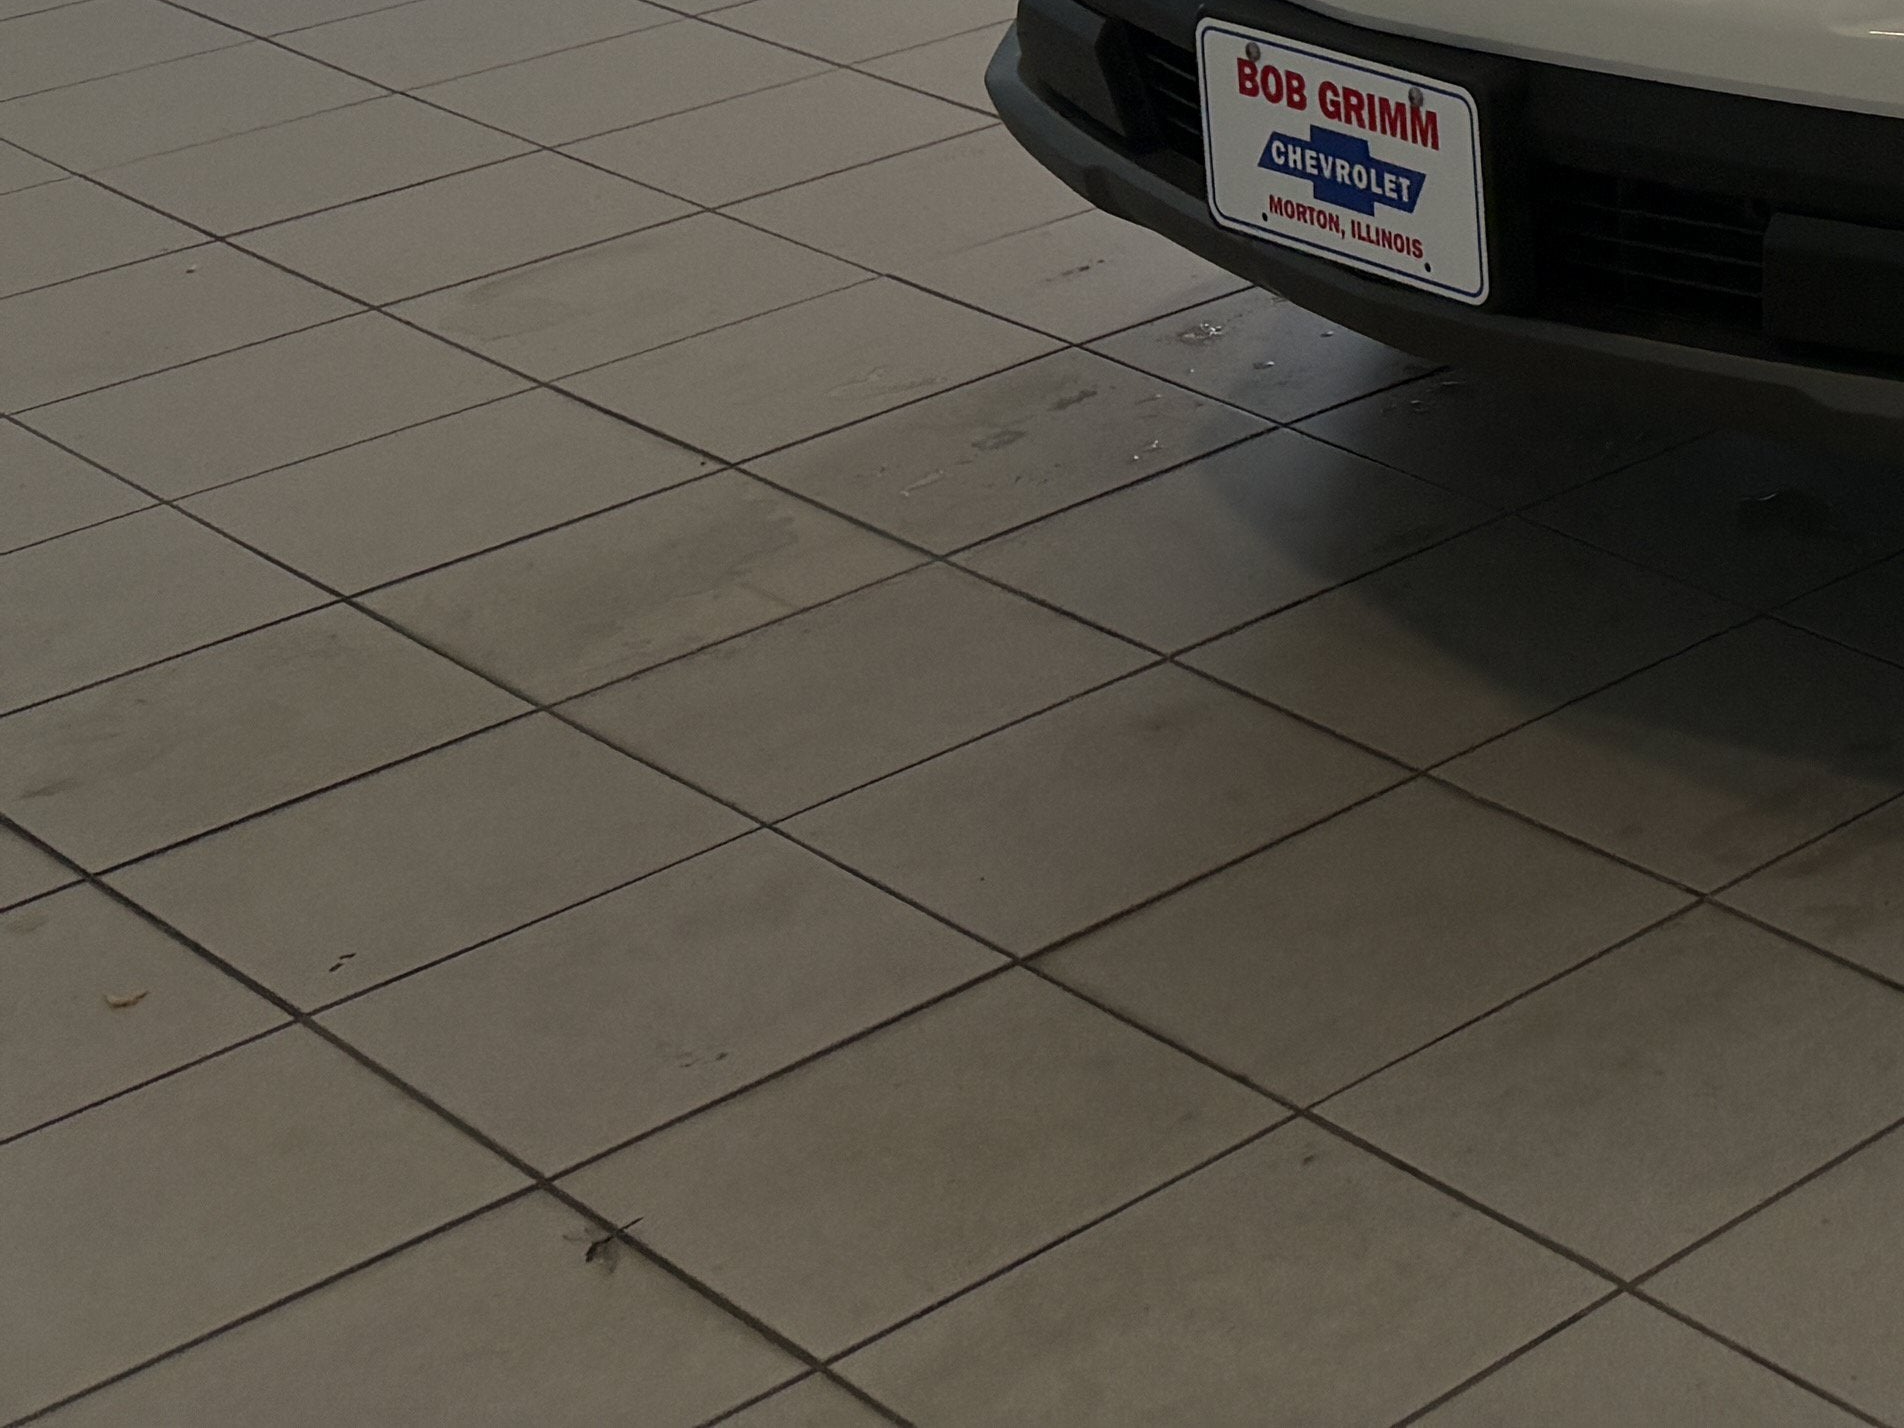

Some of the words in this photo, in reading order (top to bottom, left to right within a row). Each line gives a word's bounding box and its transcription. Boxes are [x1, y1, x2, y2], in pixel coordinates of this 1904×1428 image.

[1237, 57, 1308, 111] BOB
[1318, 80, 1440, 151] GRIMM
[1271, 140, 1411, 203] CHEVROLET
[1268, 194, 1346, 240] MORTON,
[1351, 220, 1424, 259] ILLINOIS
